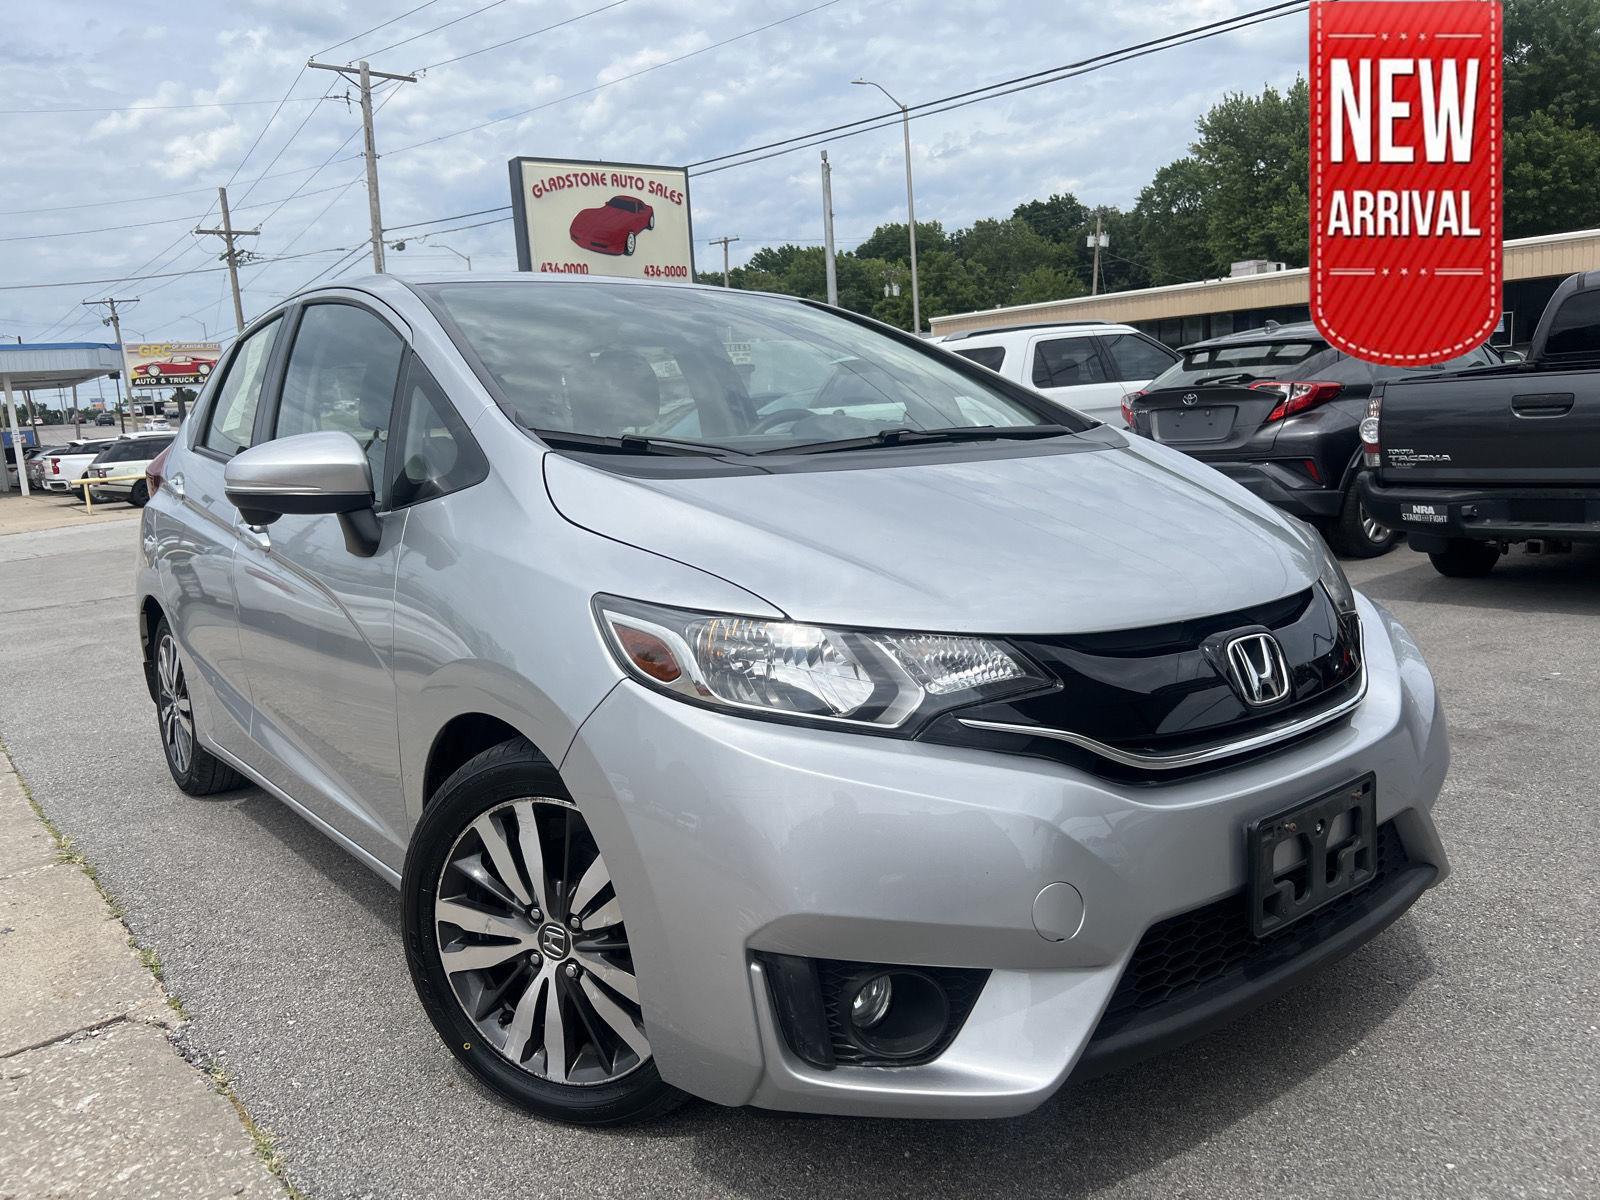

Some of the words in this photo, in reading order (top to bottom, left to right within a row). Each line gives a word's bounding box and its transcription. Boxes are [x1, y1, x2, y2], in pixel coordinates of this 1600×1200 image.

[532, 172, 607, 198] GLADSTONE
[611, 173, 644, 190] AUTO
[648, 180, 683, 205] SALES
[644, 265, 687, 277] 436-0000
[139, 345, 172, 357] GRC
[1412, 505, 1435, 514] NRA
[1402, 513, 1421, 521] STAND
